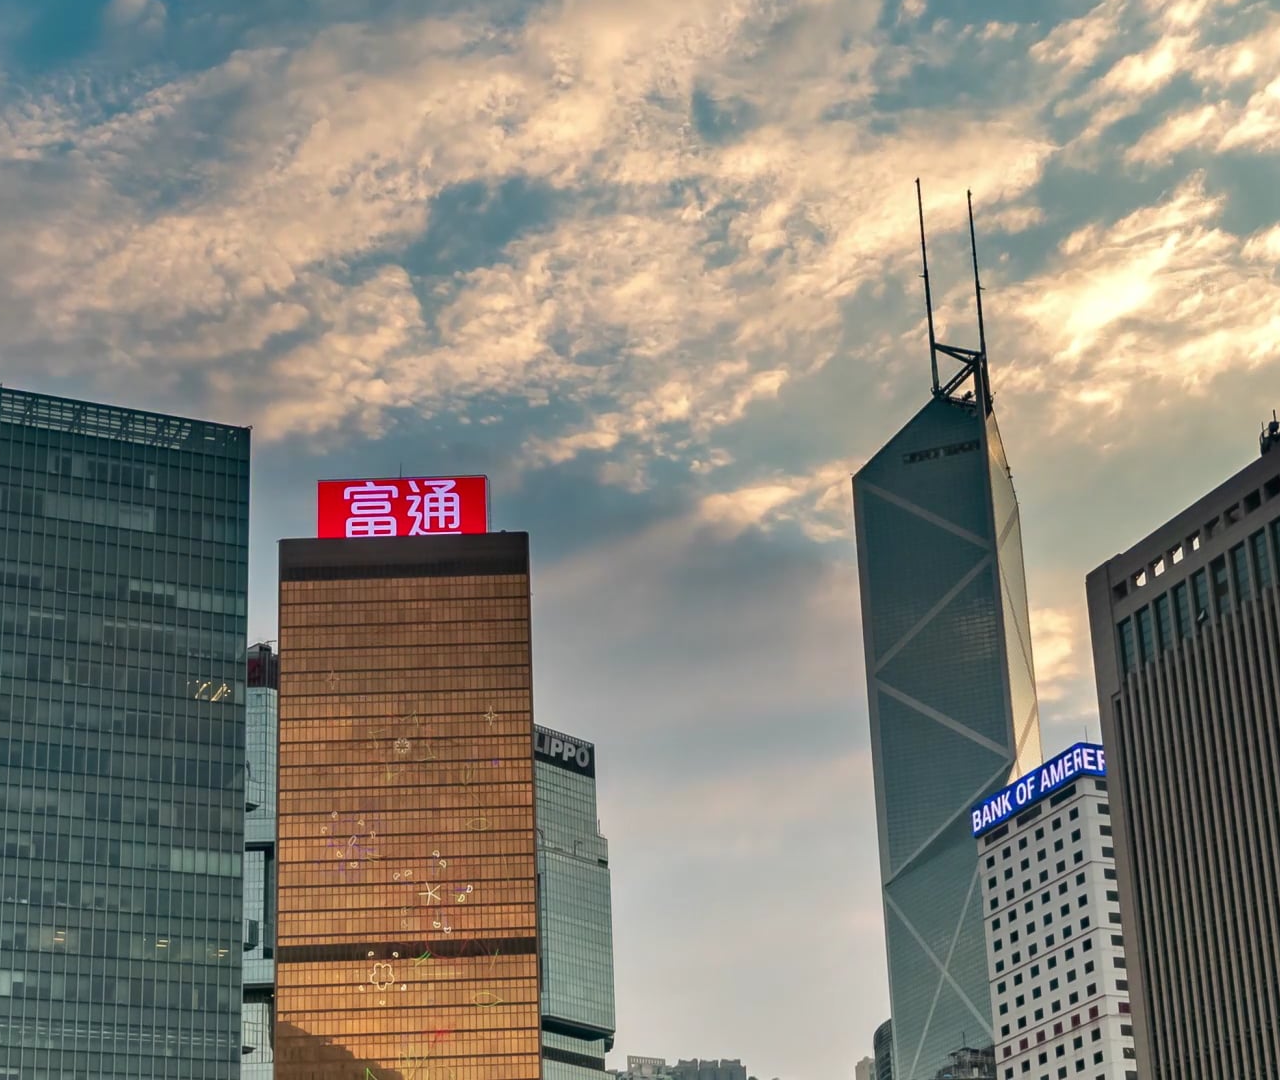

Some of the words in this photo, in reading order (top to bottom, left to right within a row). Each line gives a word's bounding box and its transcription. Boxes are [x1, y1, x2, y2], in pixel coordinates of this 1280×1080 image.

[344, 480, 462, 538] 富通
[535, 732, 589, 768] LIPPO
[972, 790, 1012, 833] BANK
[1016, 776, 1035, 806] OF
